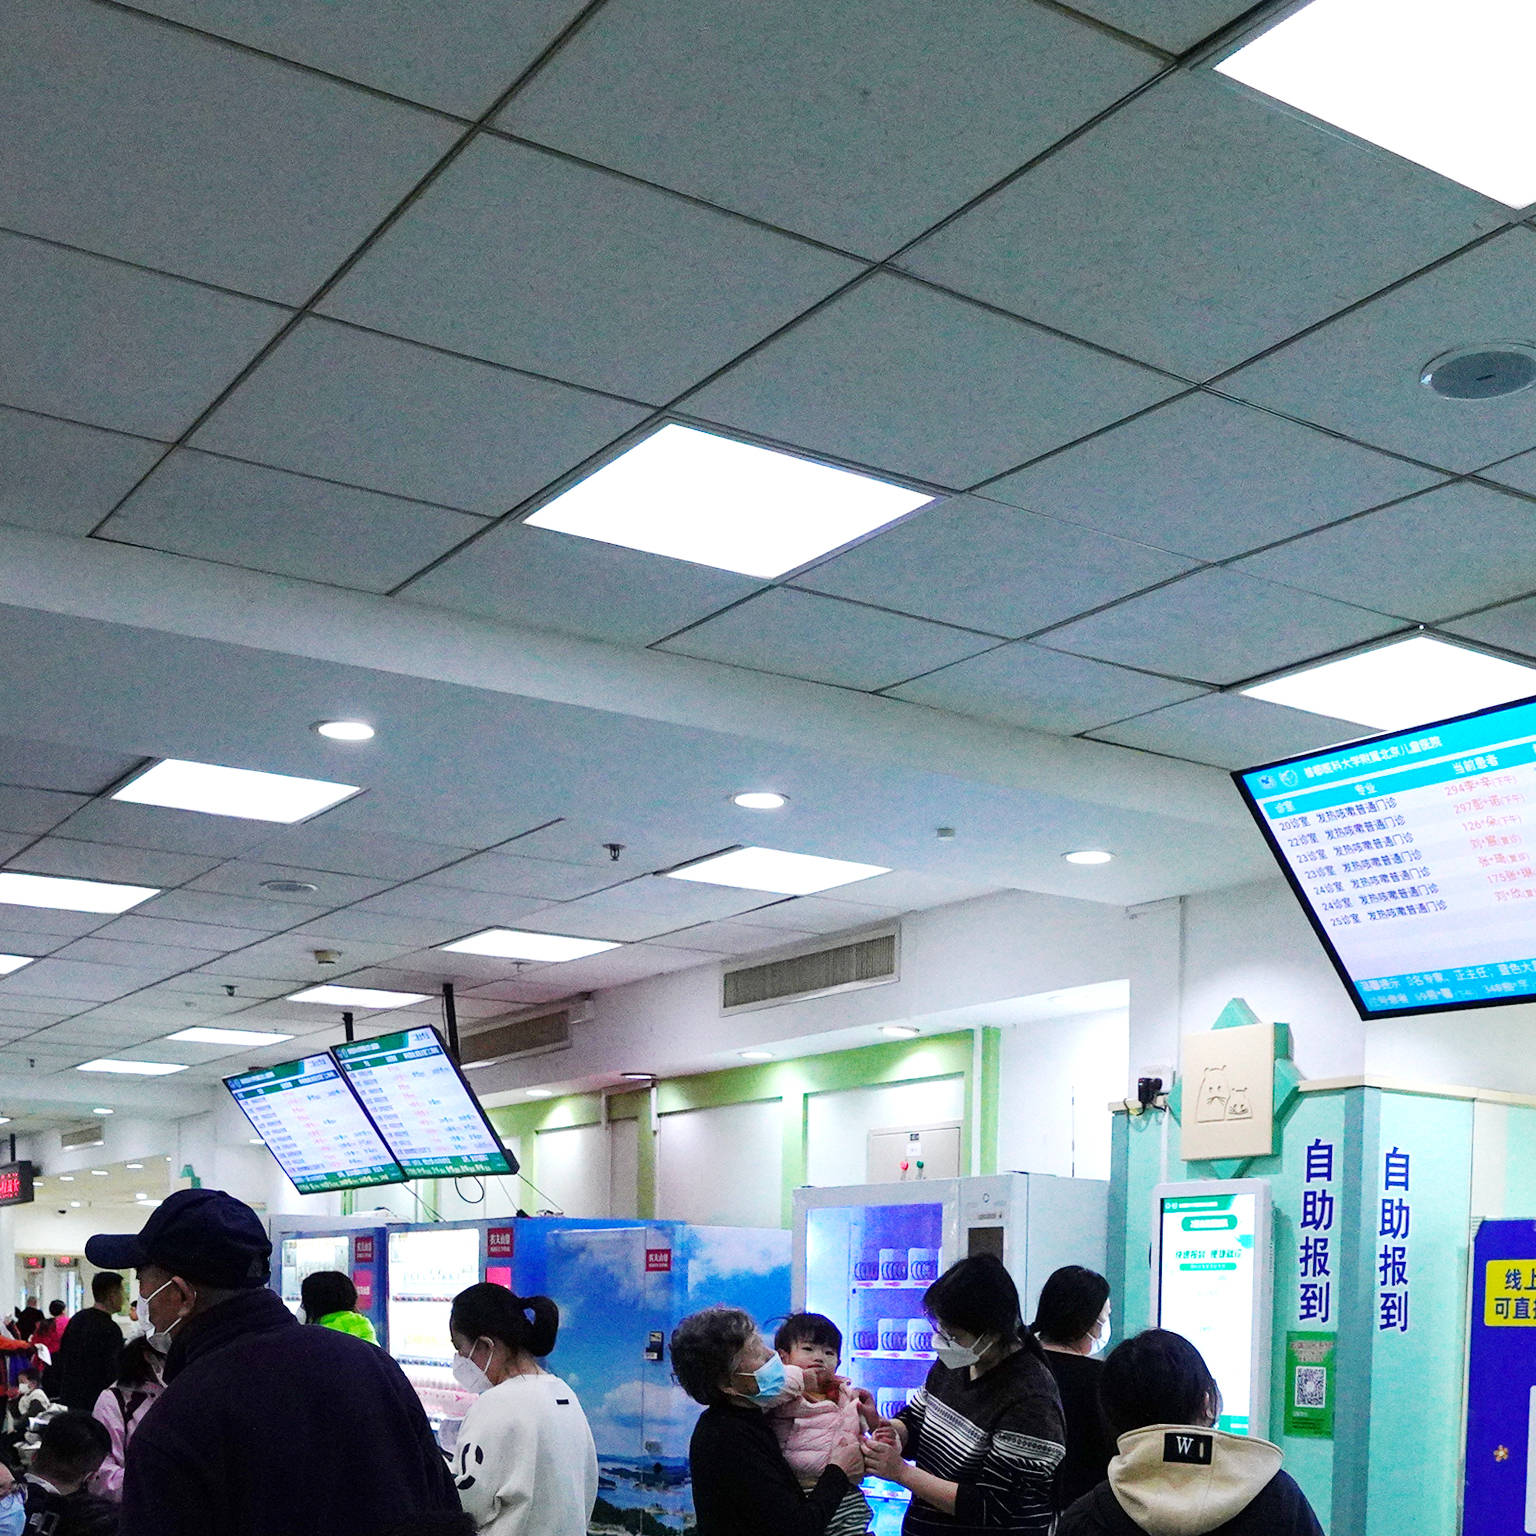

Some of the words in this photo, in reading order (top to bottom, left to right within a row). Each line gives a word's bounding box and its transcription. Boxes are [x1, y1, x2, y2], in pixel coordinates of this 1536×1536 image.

[1300, 1138, 1335, 1323] 自助报到
[1379, 1147, 1411, 1333] 自助报到
